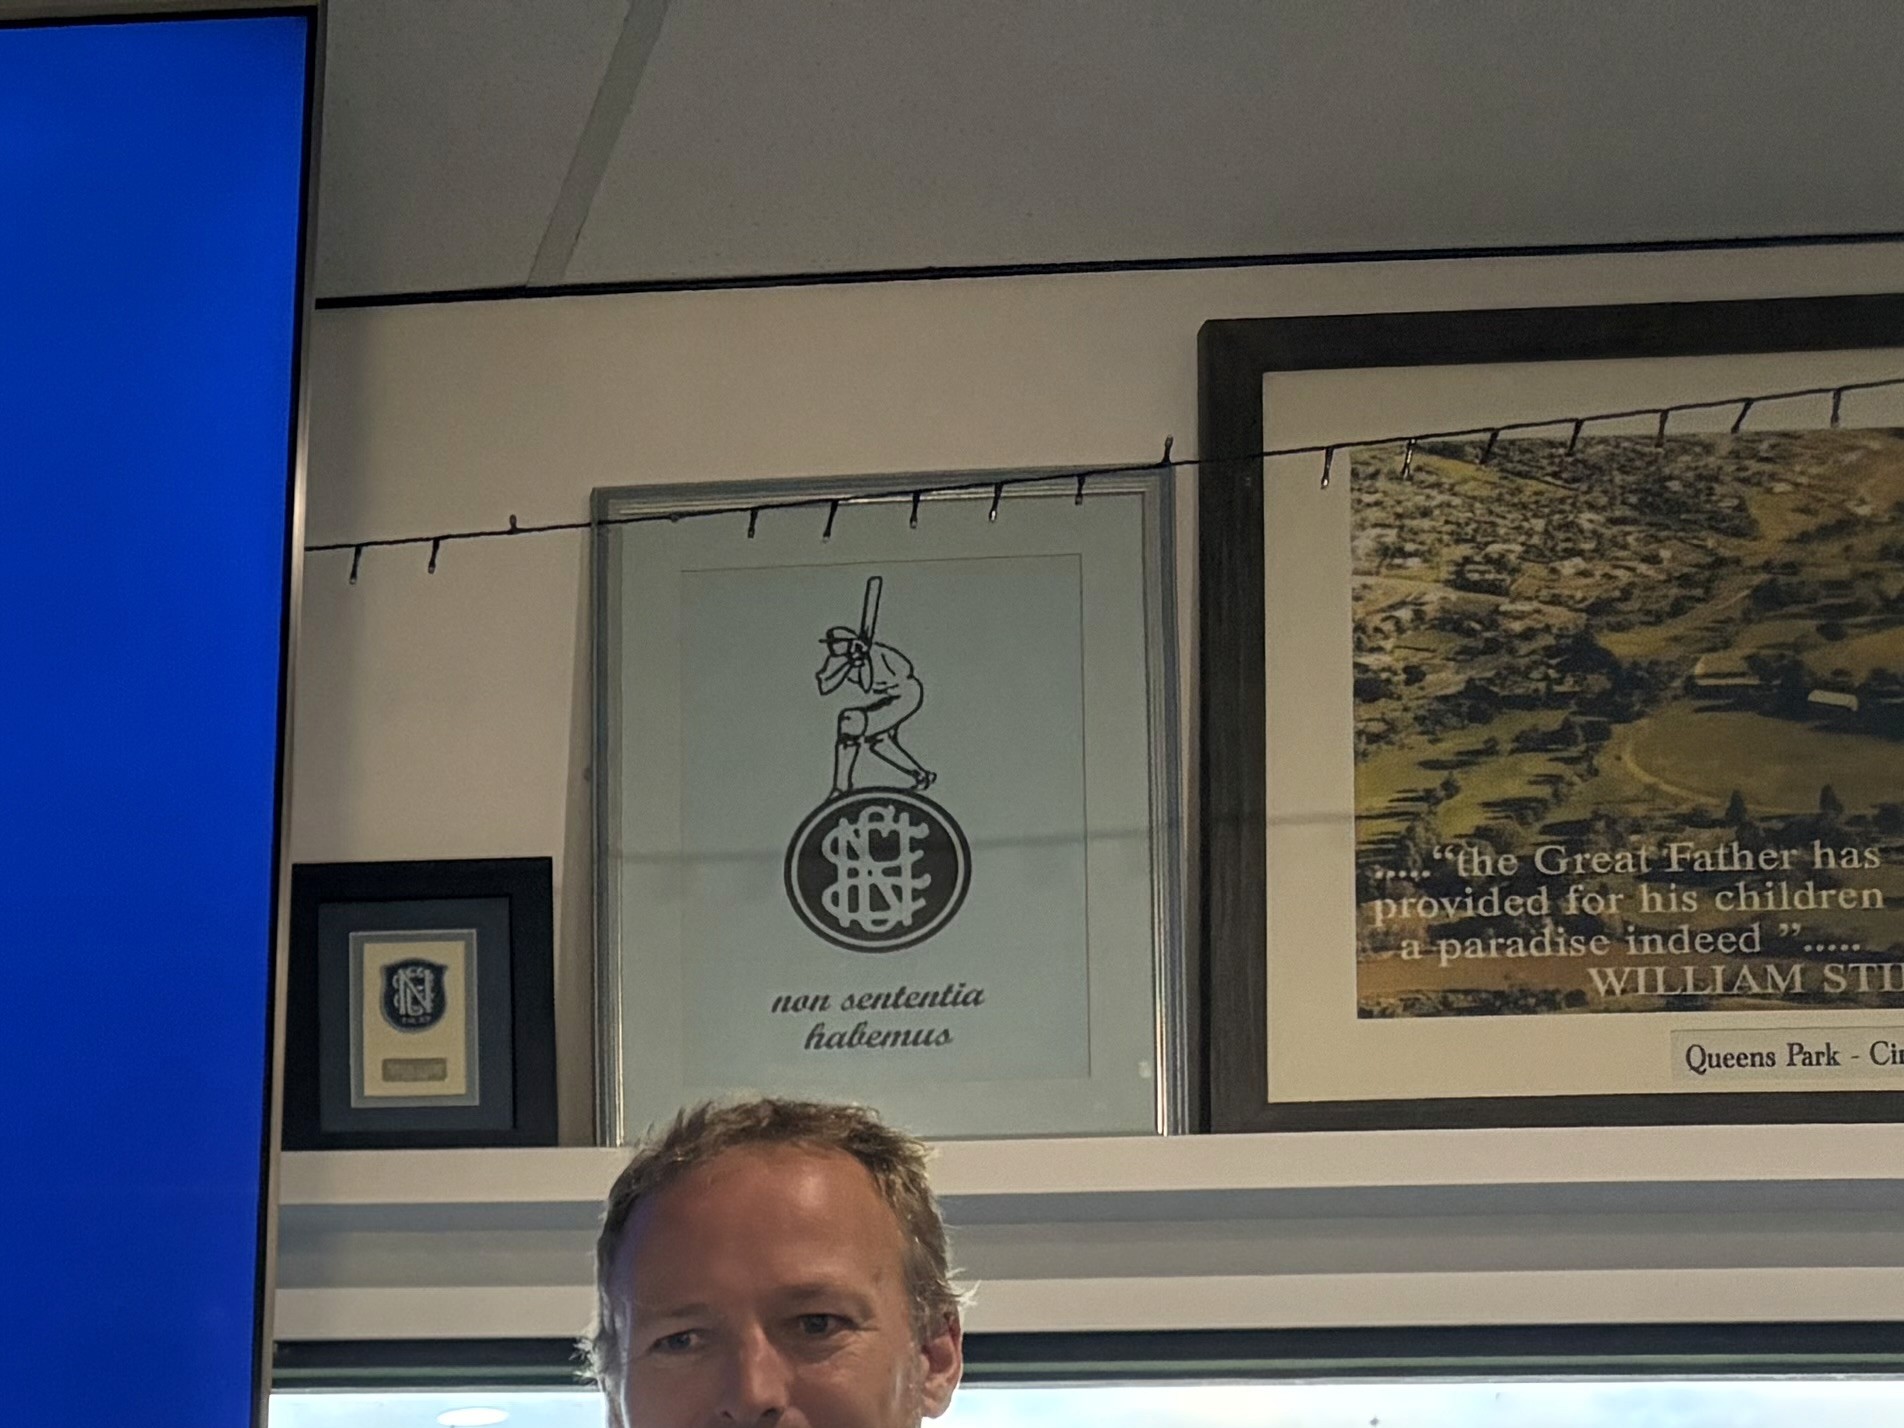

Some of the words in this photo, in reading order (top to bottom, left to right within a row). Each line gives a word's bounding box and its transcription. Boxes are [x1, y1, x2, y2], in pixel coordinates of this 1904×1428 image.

[1534, 844, 1651, 876] Great
[1661, 842, 1793, 873] Father
[1812, 840, 1882, 872] has
[1373, 886, 1550, 927] provided
[1563, 884, 1626, 917] for
[1639, 883, 1699, 915] his
[1714, 879, 1886, 914] children
[1400, 938, 1423, 961] a
[1438, 927, 1611, 967] paradise
[1624, 924, 1762, 957] indeed
[1587, 963, 1805, 997] WILLIAM
[770, 989, 831, 1016] non
[840, 982, 986, 1012] sententia
[803, 1020, 953, 1051] habemus
[1685, 1043, 1776, 1074] Queens
[1786, 1042, 1841, 1067] Park
